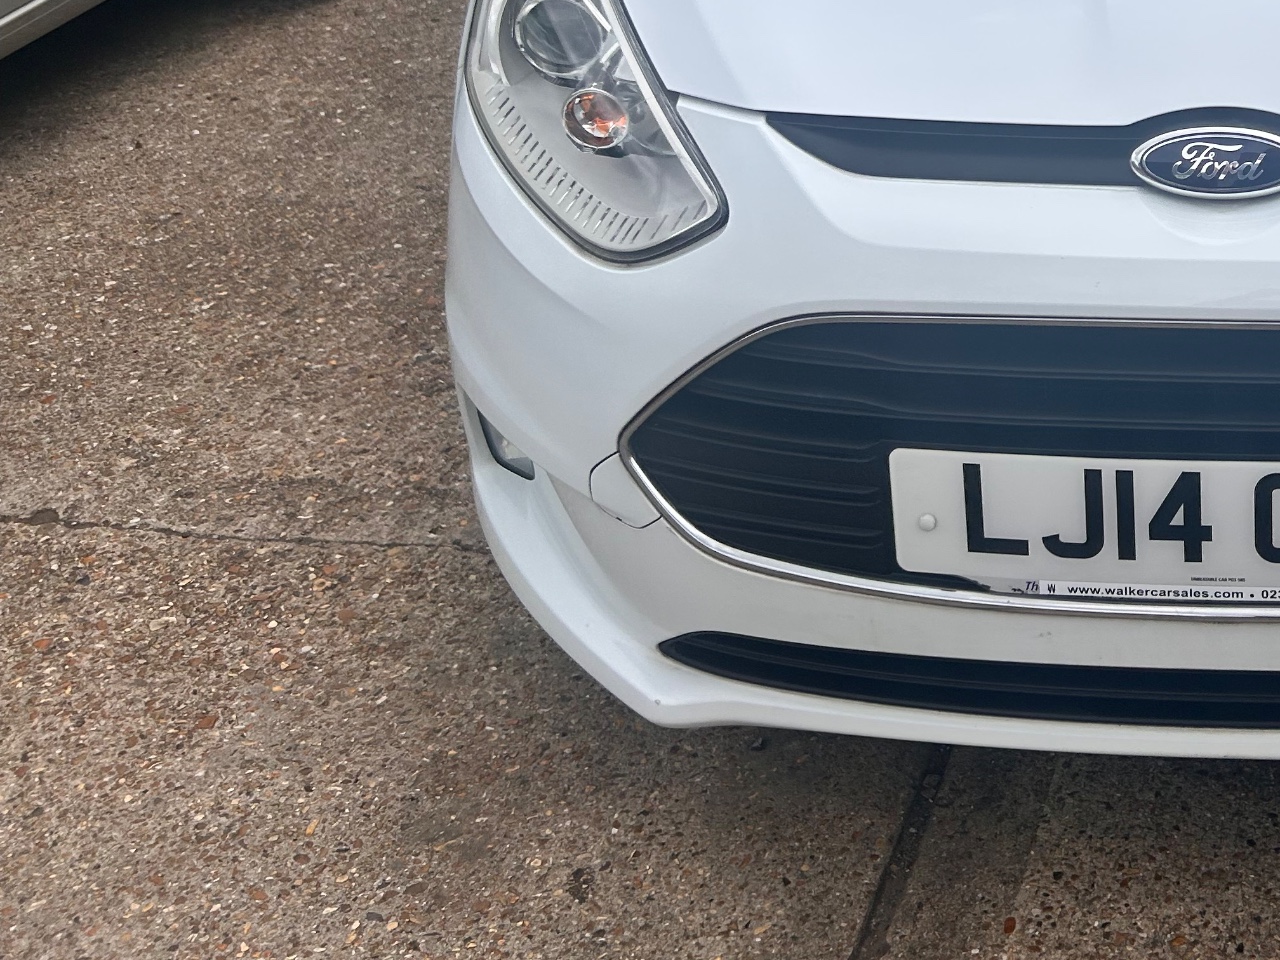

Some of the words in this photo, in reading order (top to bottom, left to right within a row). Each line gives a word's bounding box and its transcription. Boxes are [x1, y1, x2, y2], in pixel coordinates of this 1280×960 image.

[1171, 141, 1267, 181] Ford
[962, 462, 1213, 563] LJ14
[1067, 584, 1244, 599] www.walkercarsales.com
